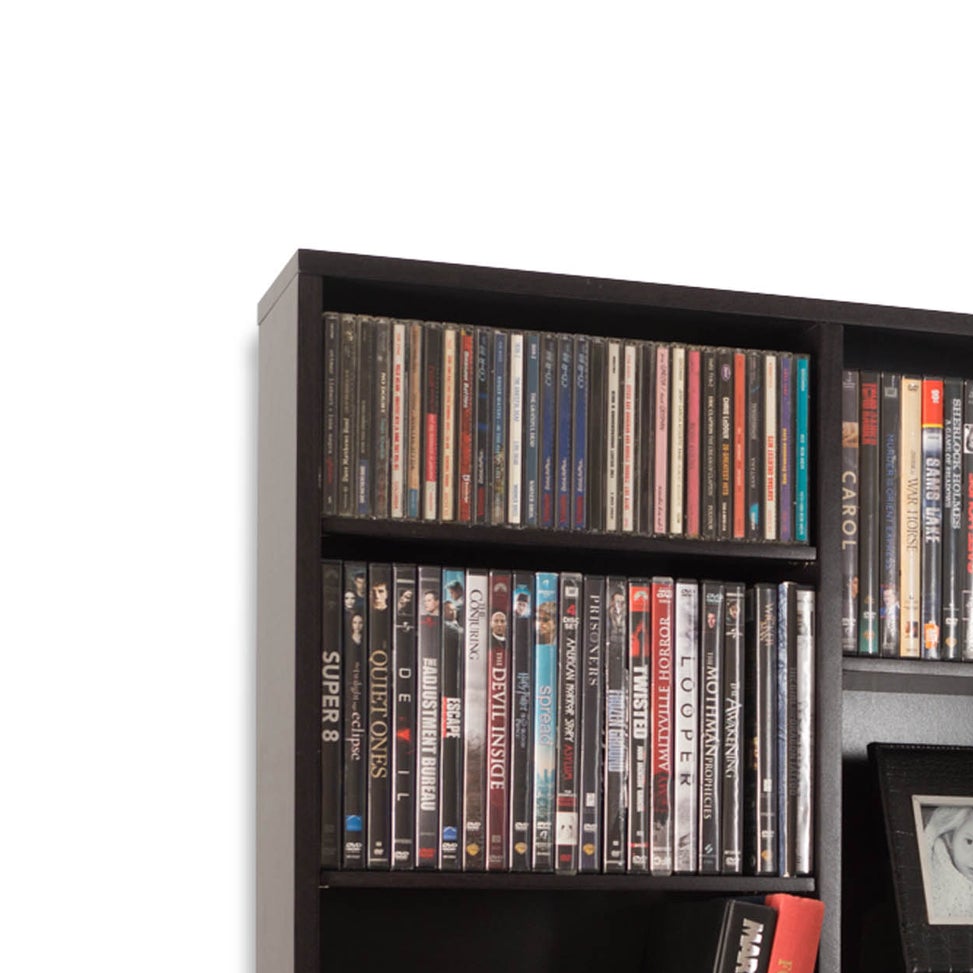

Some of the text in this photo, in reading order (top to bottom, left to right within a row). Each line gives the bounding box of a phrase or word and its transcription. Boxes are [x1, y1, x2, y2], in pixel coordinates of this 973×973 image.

[886, 434, 894, 475] MURDER
[952, 399, 961, 529] SHERLOCK HOLMES
[842, 471, 856, 550] CAROL
[906, 478, 918, 505] WAR
[885, 526, 893, 570] EXPRESS
[906, 510, 918, 552] HORSE
[926, 508, 939, 543] LAKE
[469, 590, 483, 660] CONJURING
[589, 595, 599, 685] PRISONERS
[565, 638, 576, 680] AMERICAN
[323, 651, 339, 742] SUPER 8
[369, 650, 388, 778] QUIET ONES
[421, 666, 436, 753] ADJUSTMENT
[447, 697, 460, 738] ESCAPE
[492, 667, 506, 720] DEVIL
[537, 685, 553, 746] spread
[565, 684, 575, 716] HORROR
[634, 665, 648, 738] TWISTED
[658, 617, 670, 771] AMITYVILLE HORROR
[680, 656, 693, 787] LOOPER
[705, 666, 717, 757] MOTHMAN
[347, 712, 364, 761] eclipse
[491, 726, 506, 789] INSIDE
[564, 718, 576, 742] STORY
[608, 690, 624, 772] FROZEN GROUND
[725, 698, 741, 778] AWAKENING
[421, 757, 435, 810] BUREAU
[704, 758, 712, 819] PROPHECIES
